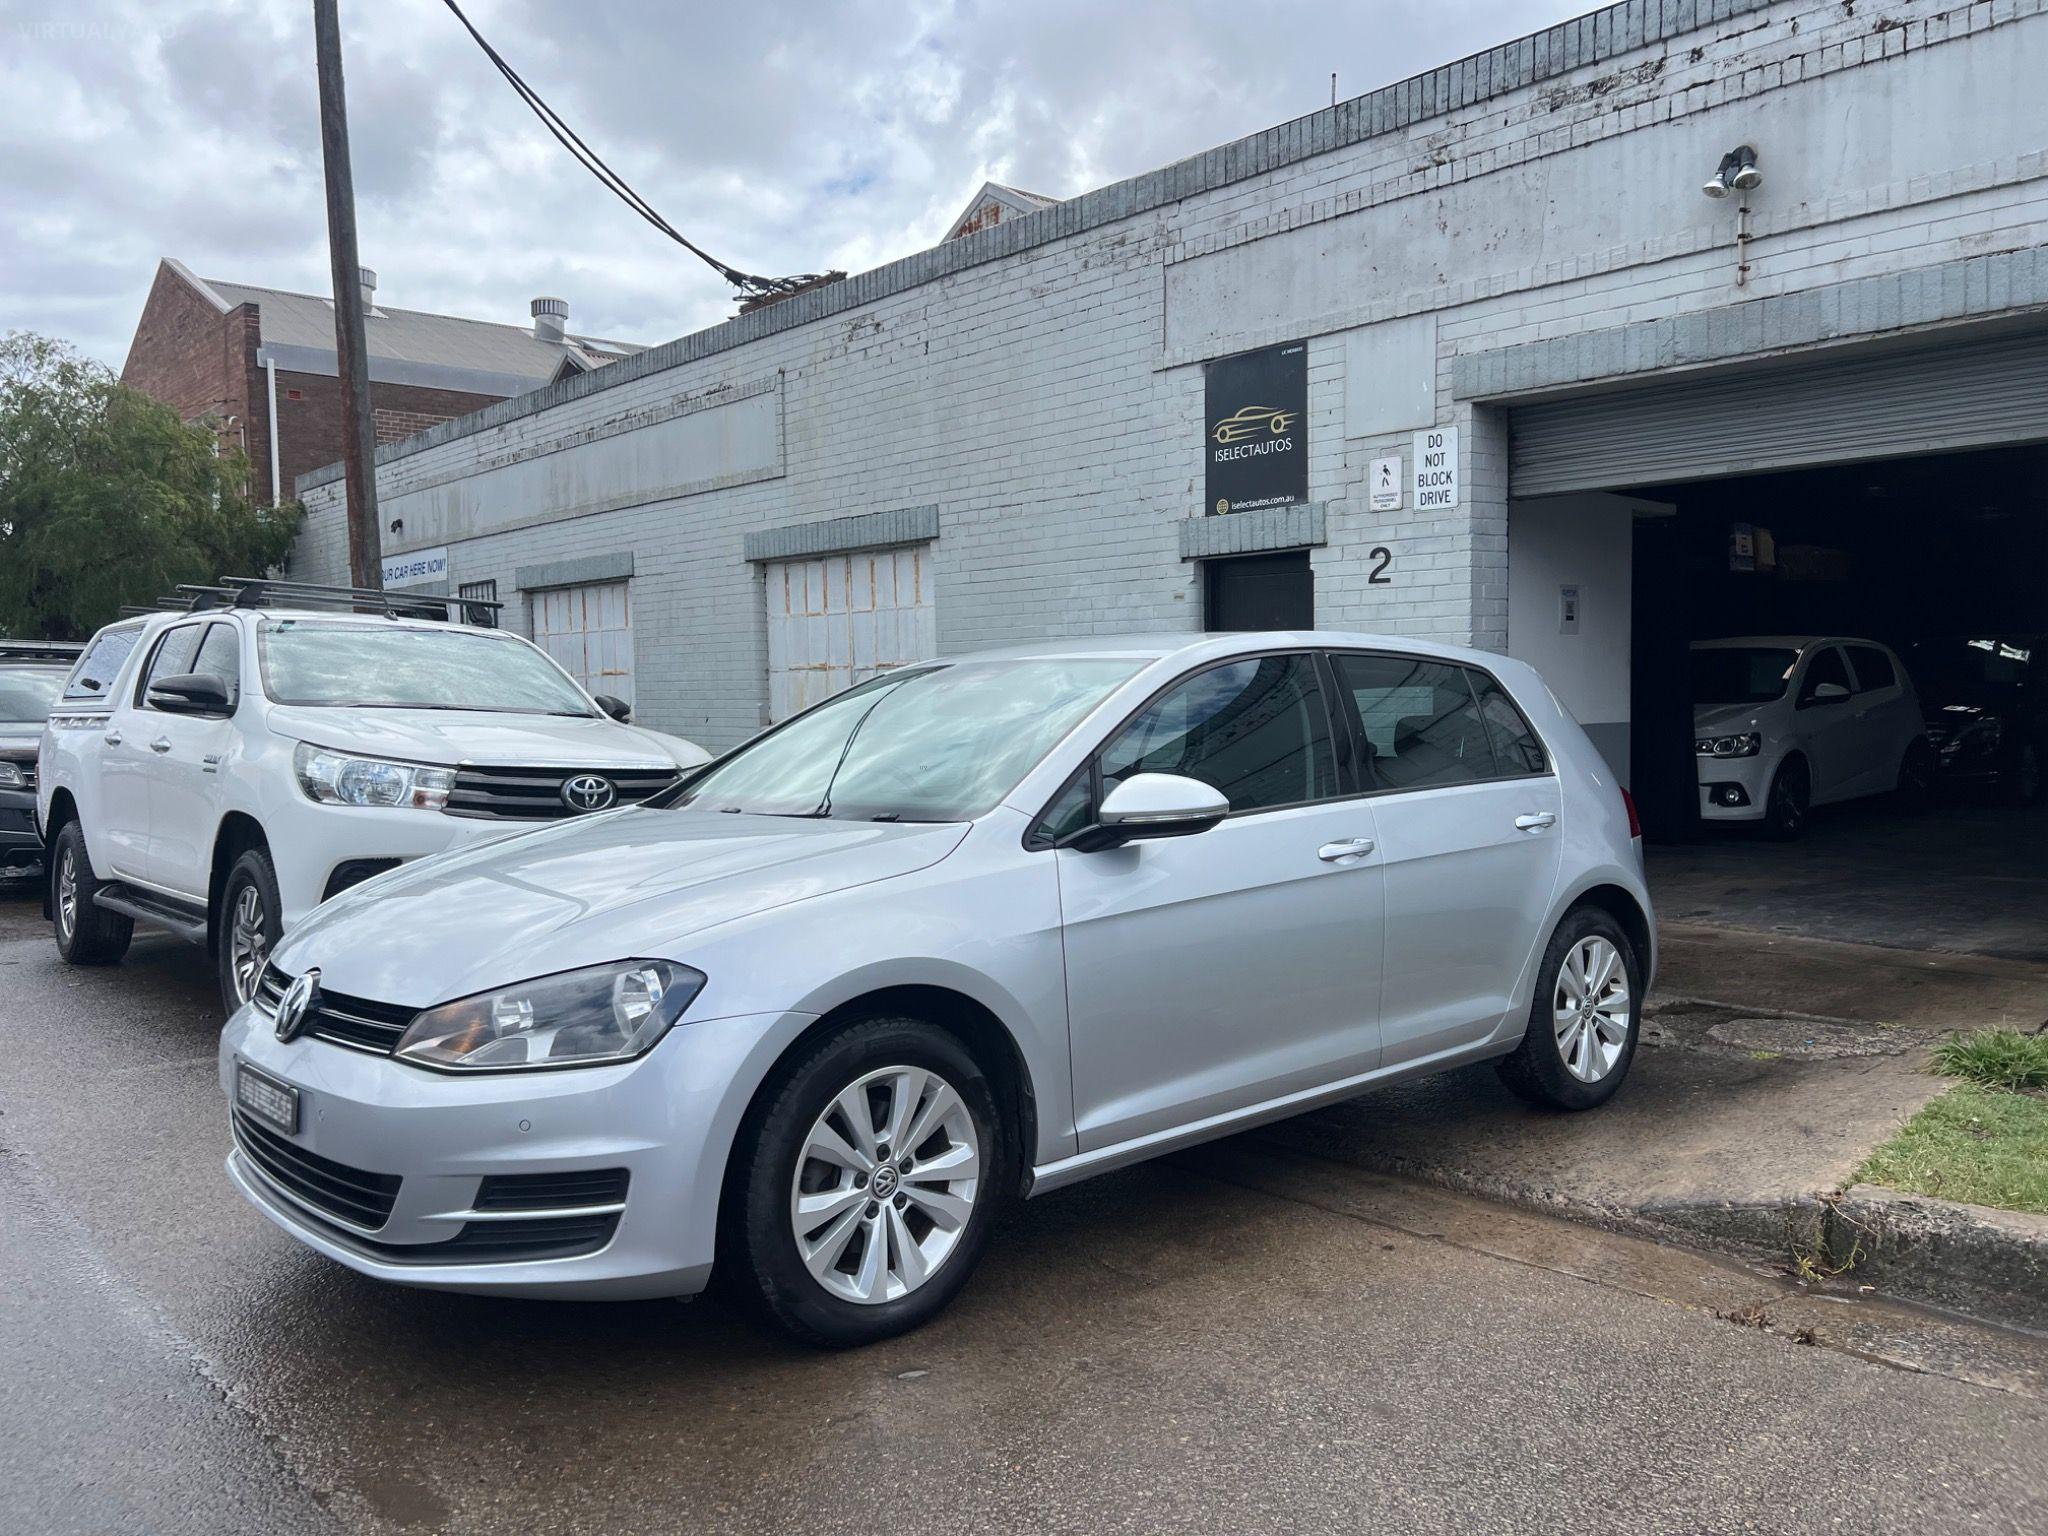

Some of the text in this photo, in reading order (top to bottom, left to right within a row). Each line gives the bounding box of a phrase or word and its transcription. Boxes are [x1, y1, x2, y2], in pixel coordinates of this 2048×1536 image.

[1428, 433, 1443, 449] DO
[1215, 437, 1292, 463] ISELECTAUTOS
[1425, 452, 1446, 468] NOT
[1418, 470, 1453, 488] BLOCK
[1231, 495, 1295, 510] iselectautos.com.au
[1420, 489, 1451, 506] DRIVE
[395, 565, 409, 580] CAR
[409, 562, 426, 576] HERE
[428, 558, 446, 573] NOW!
[1368, 546, 1392, 584] 2
